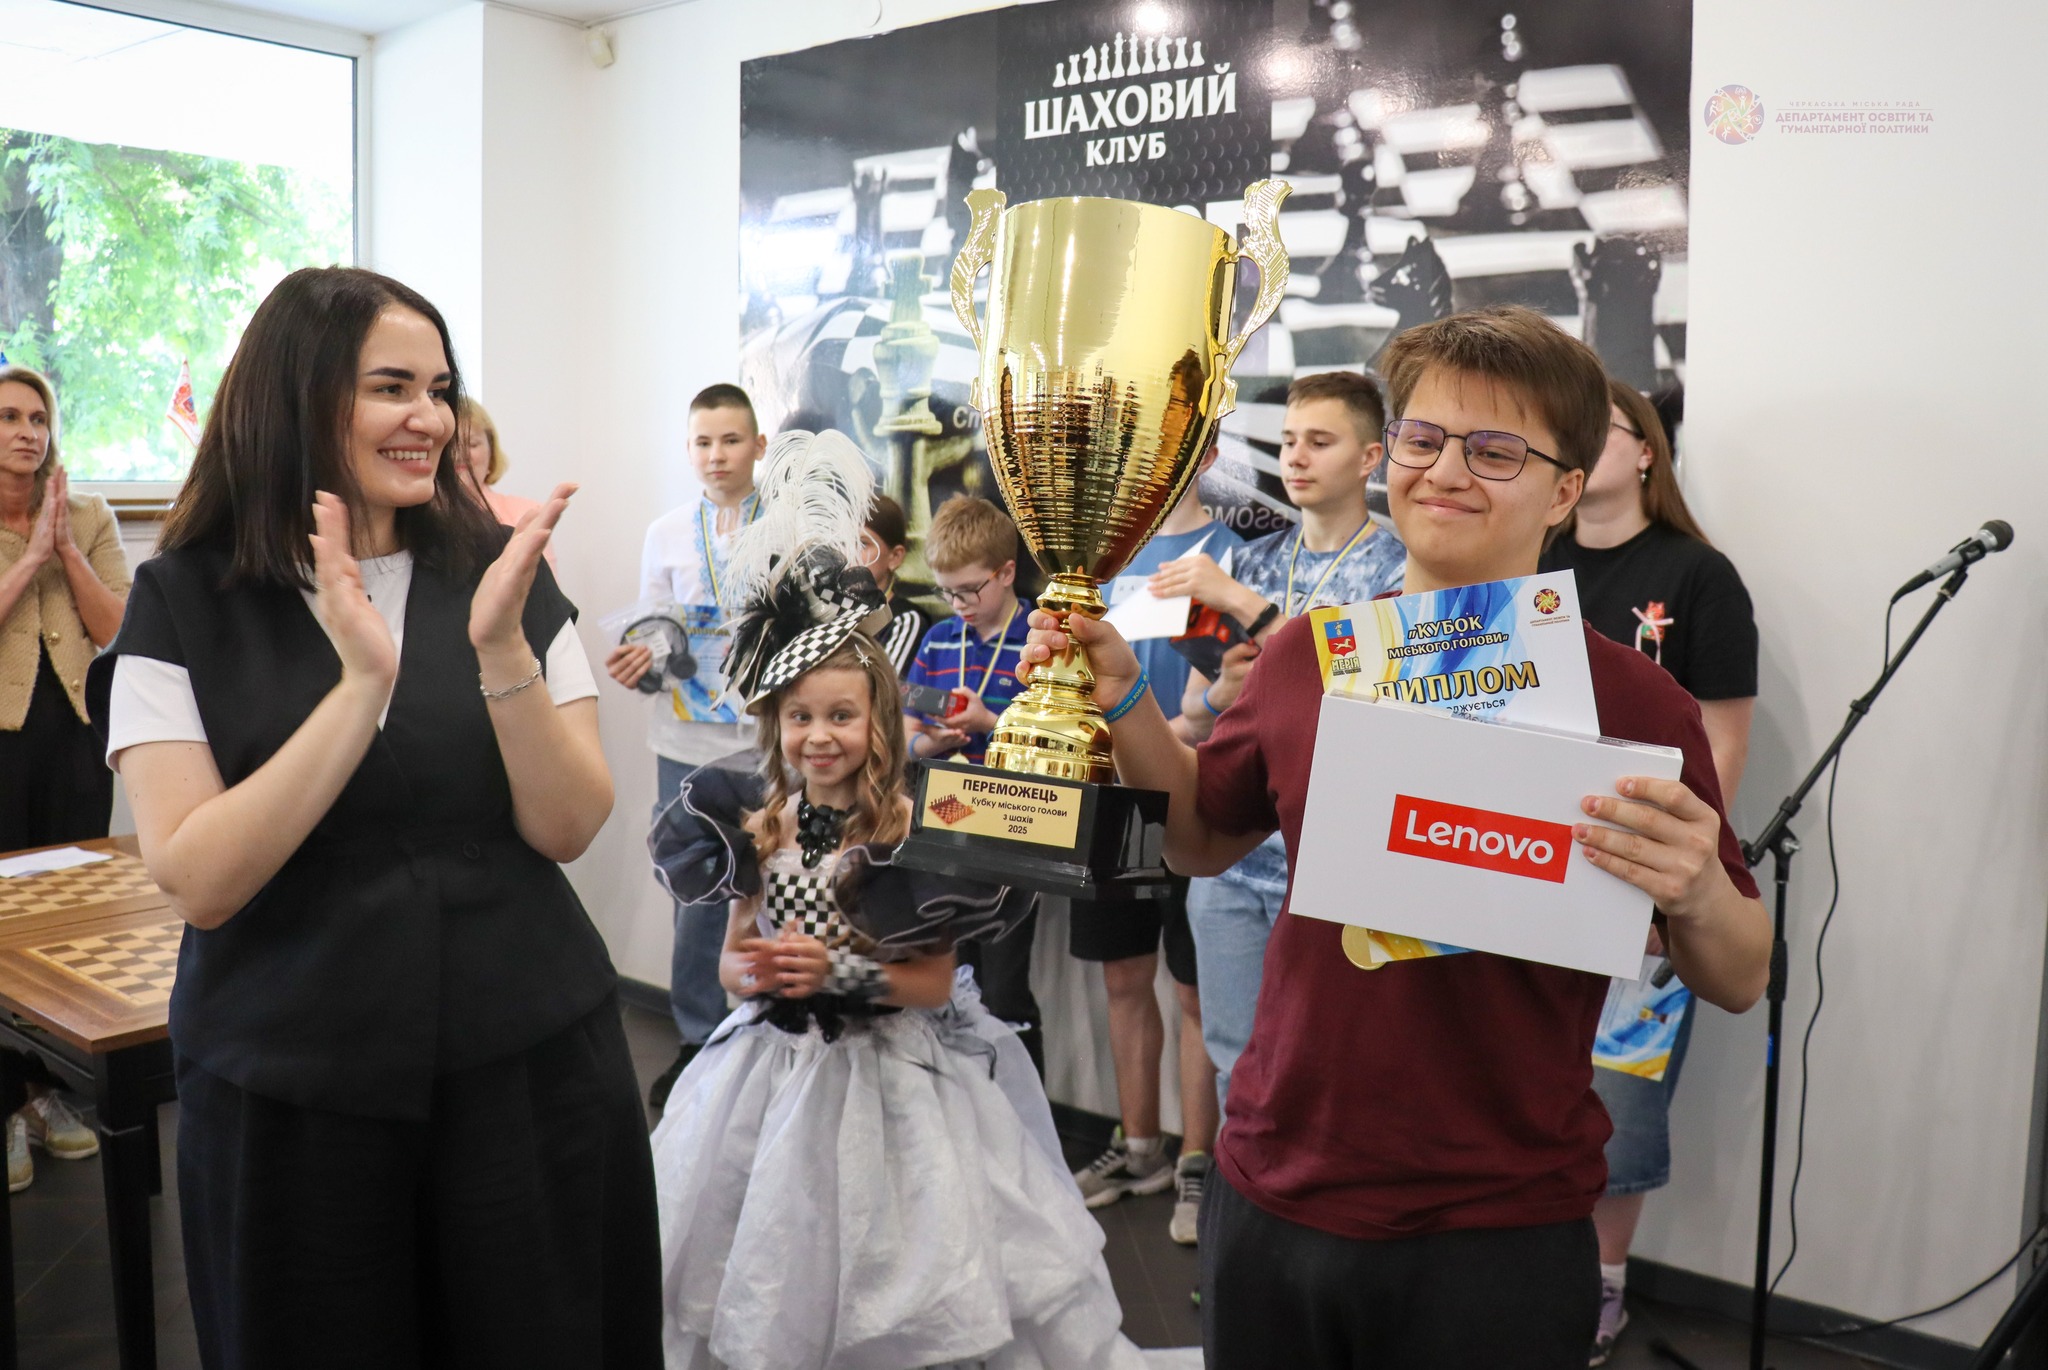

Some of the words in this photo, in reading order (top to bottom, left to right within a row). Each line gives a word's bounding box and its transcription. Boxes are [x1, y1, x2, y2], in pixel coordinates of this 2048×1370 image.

[1025, 62, 1237, 140] ШАХОВИЙ
[1086, 131, 1167, 167] КЛУБ
[1387, 641, 1451, 660] МІСЬКОГО
[1331, 656, 1361, 671] МЕРІЯ
[1373, 660, 1541, 705] ДИПЛОМ
[962, 778, 1059, 804] ПЕРЕМОЖЕЦЬ
[971, 796, 997, 809] Кубку
[998, 801, 1037, 813] міського
[1037, 807, 1068, 817] голови
[1002, 813, 1008, 821] з
[1009, 814, 1034, 824] шахів
[1007, 824, 1028, 835] 2025
[1404, 809, 1554, 865] Lenovo
